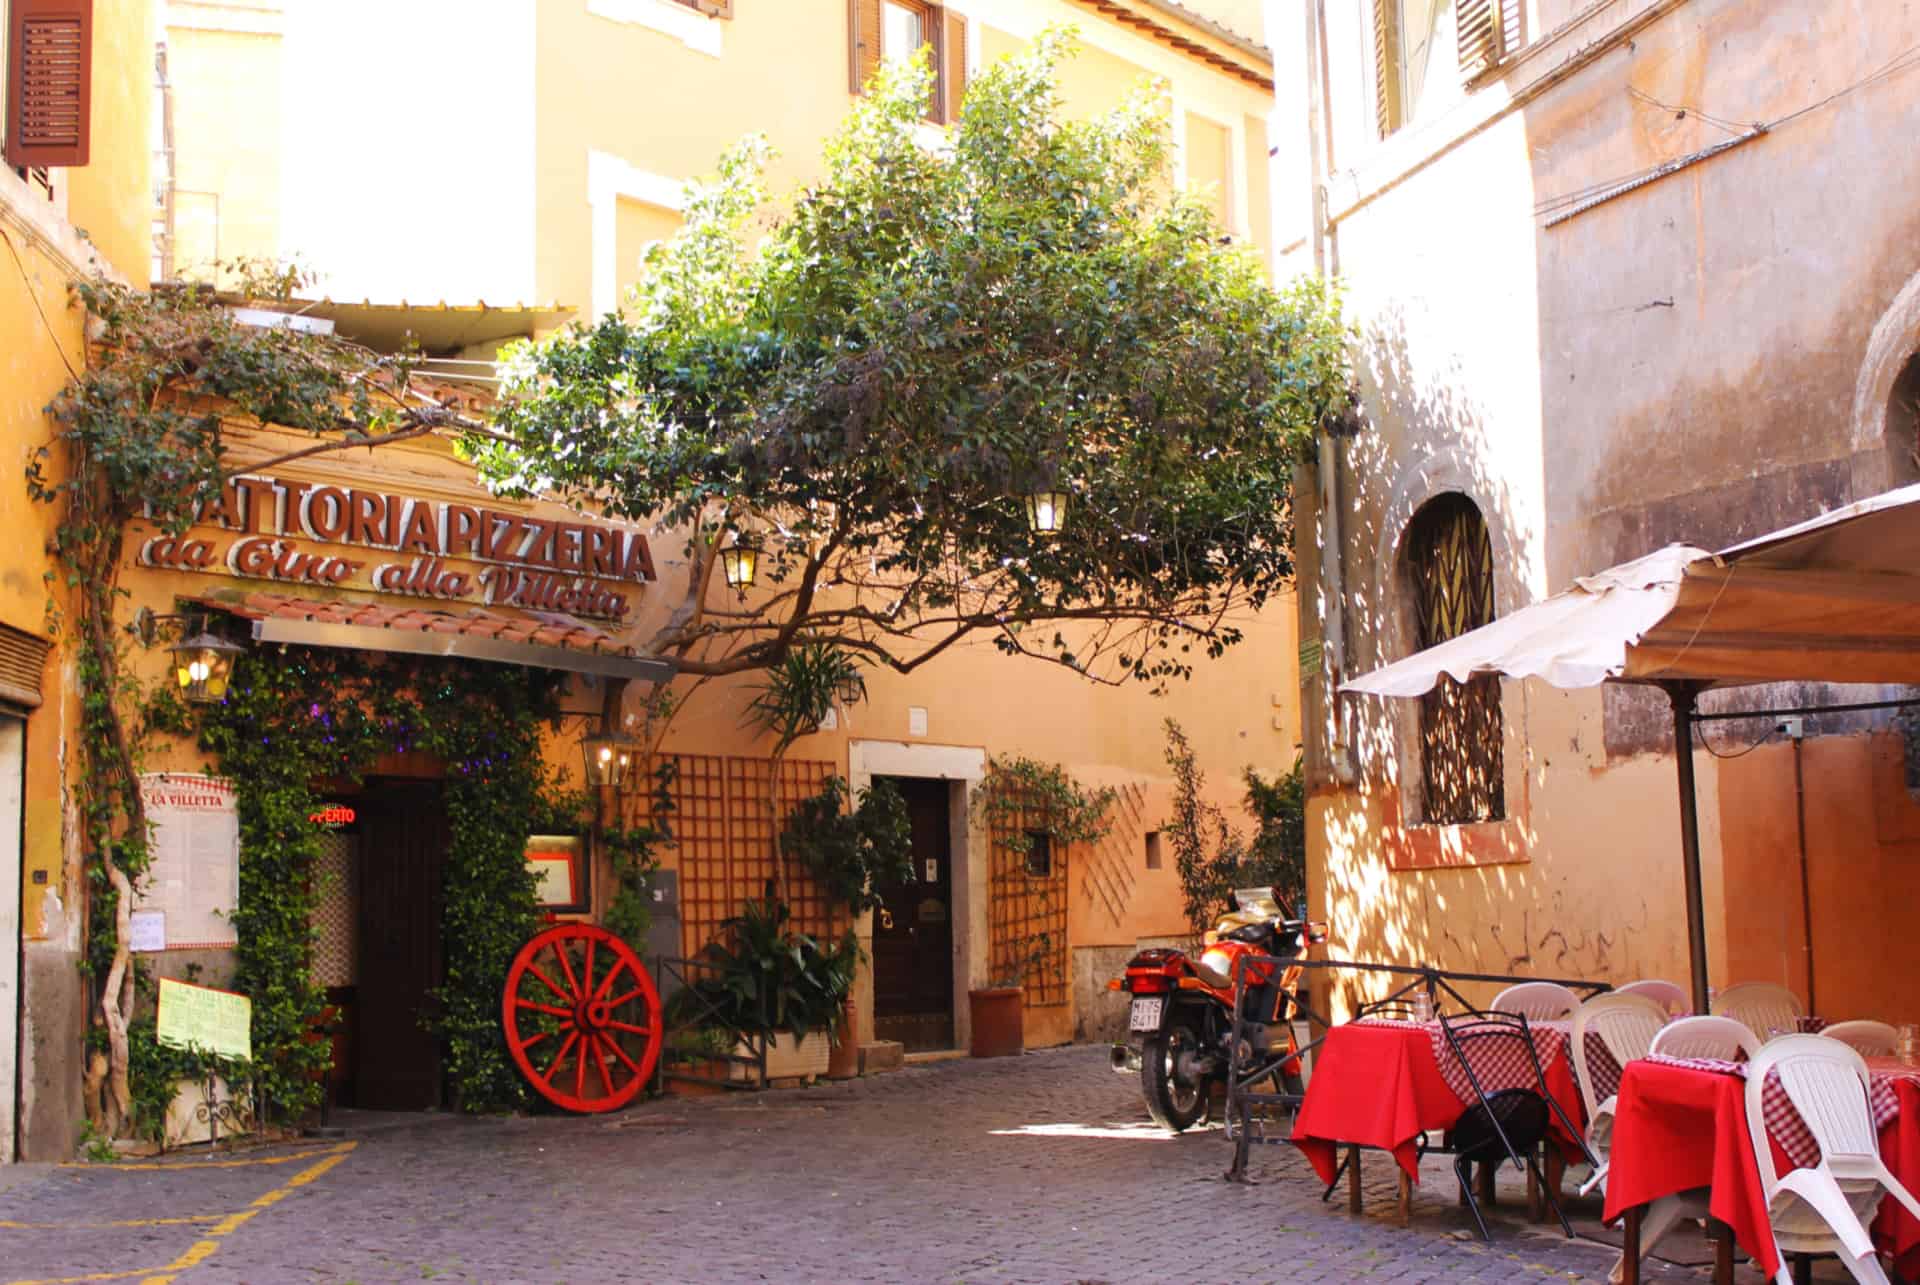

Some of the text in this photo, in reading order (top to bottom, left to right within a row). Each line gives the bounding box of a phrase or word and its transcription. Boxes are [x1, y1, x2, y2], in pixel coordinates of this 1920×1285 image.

[143, 477, 657, 582] ATTORIA PIZZERIA
[143, 534, 630, 618] da Gino alla Villetta
[151, 793, 222, 807] LA VILLETTA
